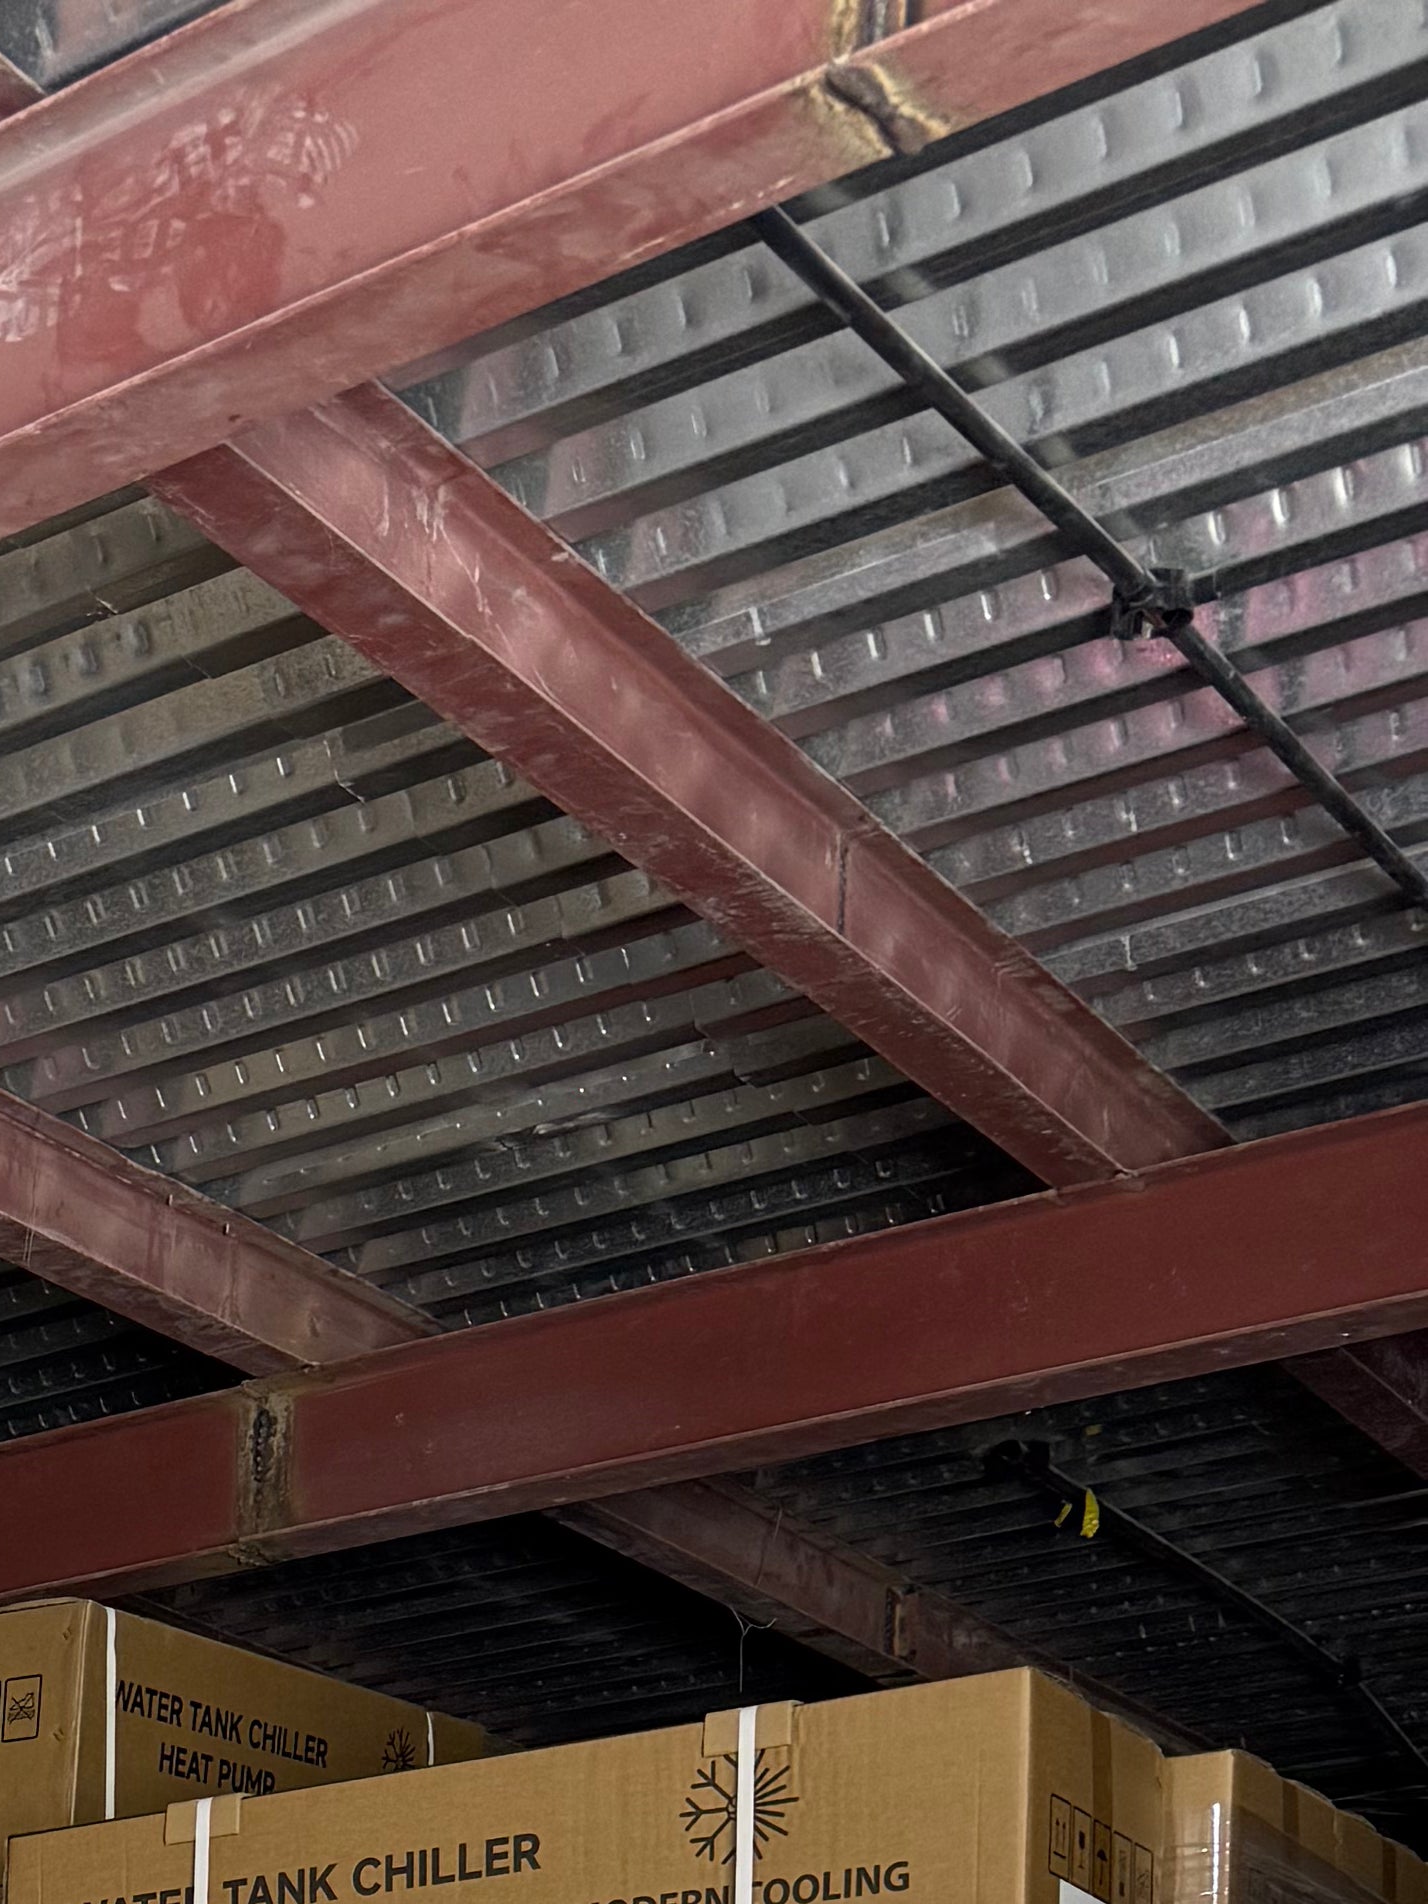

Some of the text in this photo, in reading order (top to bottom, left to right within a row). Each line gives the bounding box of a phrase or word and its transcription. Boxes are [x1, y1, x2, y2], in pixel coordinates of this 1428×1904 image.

[115, 1680, 328, 1768] WATER TANK CHILLER
[159, 1742, 275, 1796] HEAT PUMP
[352, 1833, 541, 1896] CHILLER
